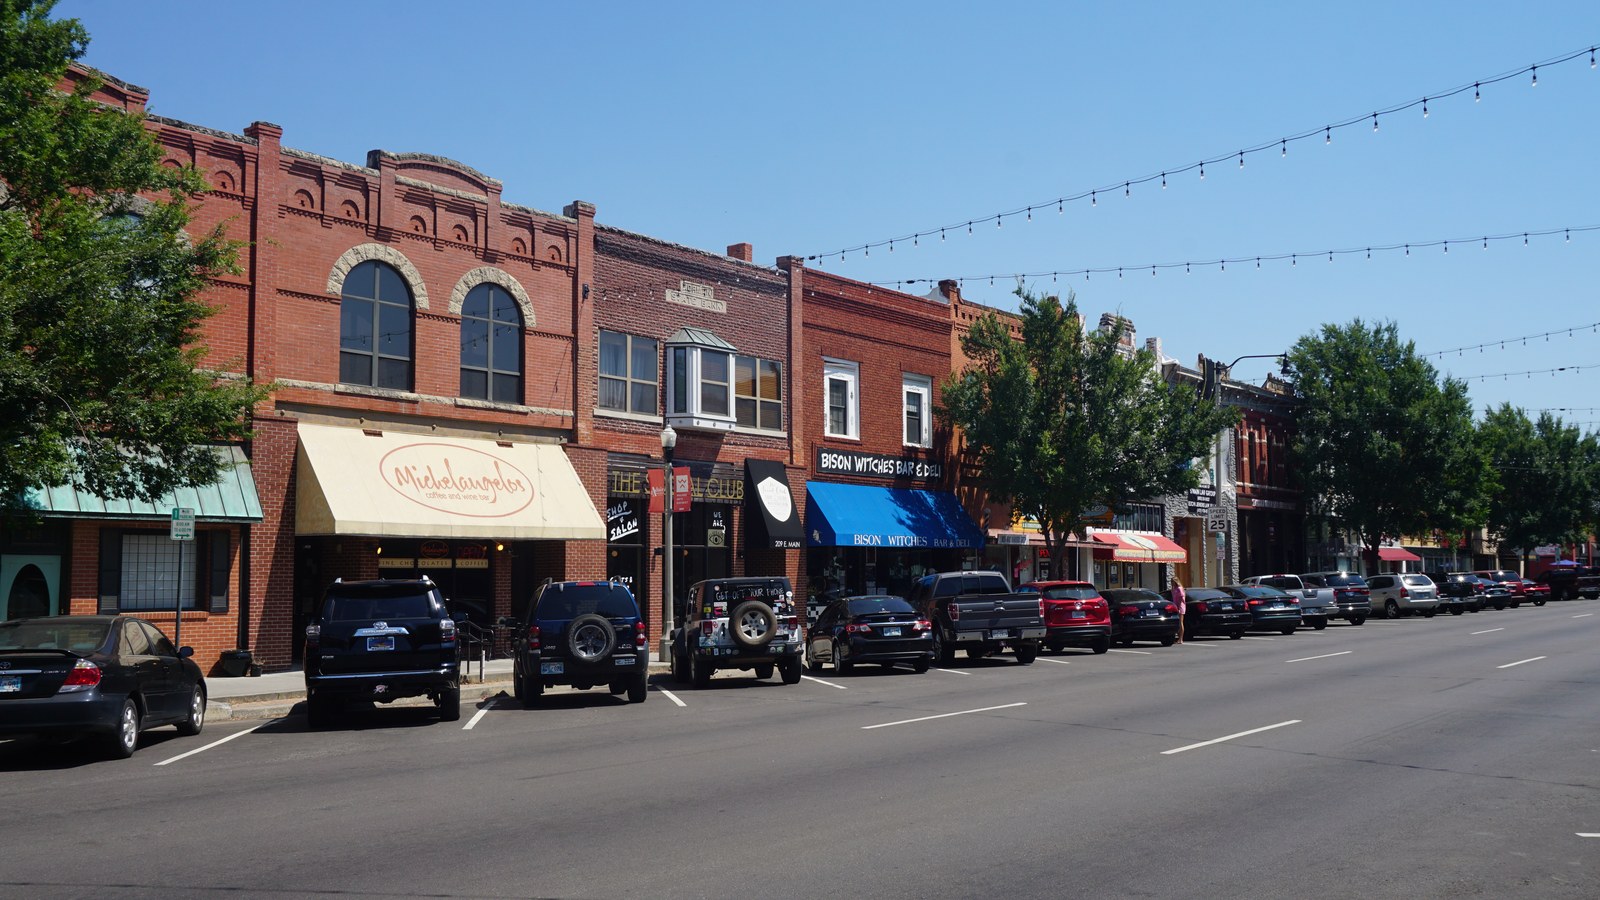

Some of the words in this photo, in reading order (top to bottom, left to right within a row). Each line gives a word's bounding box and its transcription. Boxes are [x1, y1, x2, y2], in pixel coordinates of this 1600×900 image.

[701, 300, 724, 311] BANK
[821, 453, 851, 471] BISON
[854, 455, 895, 475] WITCHES
[896, 460, 914, 476] BAR
[916, 462, 923, 477] &
[924, 464, 941, 478] DELI
[394, 458, 526, 503] Michelangelos
[612, 470, 641, 494] THE
[706, 478, 744, 500] CLUB
[425, 491, 447, 500] coffee
[448, 493, 461, 501] and
[607, 501, 628, 518] SHOP
[713, 511, 722, 519] WE
[610, 518, 638, 538] SALON
[712, 519, 723, 527] ARE
[1210, 520, 1226, 530] 25
[774, 540, 783, 548] 209
[853, 534, 882, 545] BISON
[888, 535, 928, 547] WITCHES
[933, 538, 948, 547] BAR
[956, 539, 970, 548] DELI
[715, 591, 729, 601] GET
[749, 587, 763, 597] YOUR
